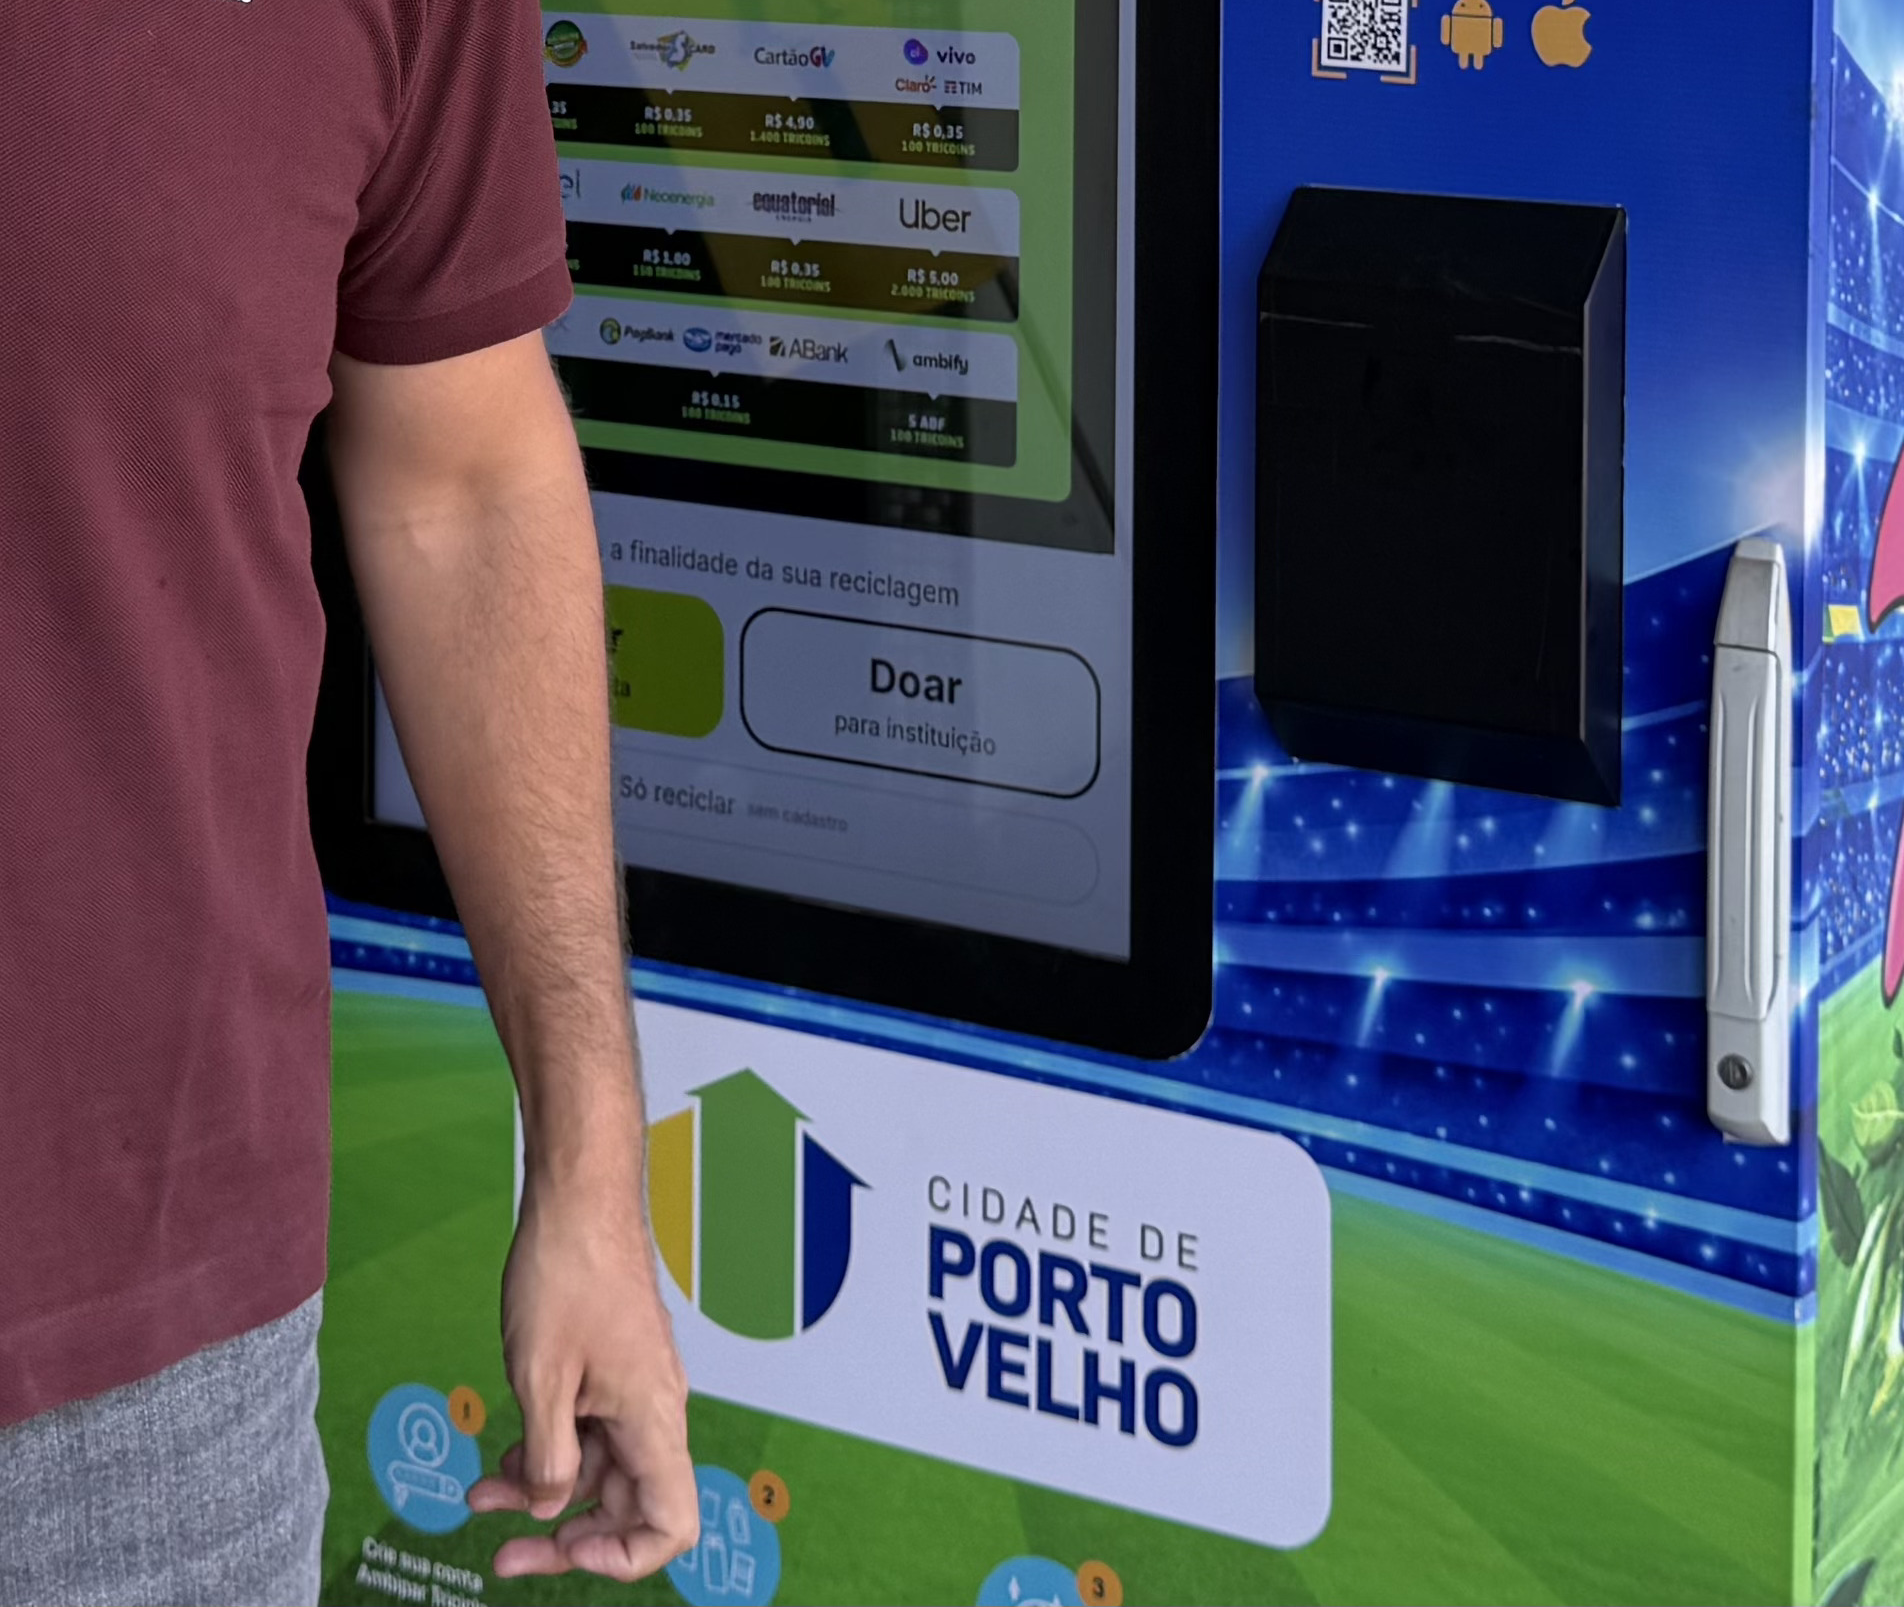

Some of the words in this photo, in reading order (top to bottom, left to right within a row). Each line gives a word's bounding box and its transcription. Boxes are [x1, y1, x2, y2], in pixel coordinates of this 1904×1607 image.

[937, 46, 976, 65] vivo
[896, 76, 934, 93] Claro
[959, 81, 983, 95] TIM
[644, 106, 660, 122] R$
[765, 113, 783, 130] R$
[785, 114, 815, 131] 4,90
[750, 130, 780, 145] 1.400
[782, 131, 831, 147] TRICOINS
[912, 122, 931, 139] R$
[933, 123, 963, 140] 0,35
[901, 139, 923, 153] 100
[925, 140, 976, 157] TRICOINS
[643, 187, 715, 209] Neoenergia
[753, 191, 836, 217] equatorial
[899, 198, 972, 233] Uber
[642, 248, 661, 265] R$
[770, 258, 788, 276] R$
[791, 260, 820, 278] 0,35
[907, 268, 926, 284] R$
[929, 271, 959, 287] 5,00
[760, 274, 781, 289] 100
[783, 276, 831, 293] TRICOINS
[891, 282, 924, 298] 2.000
[926, 286, 975, 303] TRICOINS
[715, 330, 762, 345] mercado
[715, 342, 743, 356] pago
[789, 338, 848, 363] ABank
[912, 352, 969, 375] ambify
[691, 390, 708, 406] R$
[914, 430, 965, 449] TRICOINS
[610, 543, 623, 561] a
[630, 539, 738, 576] finalidade
[745, 556, 774, 581] da
[782, 563, 822, 589] sua
[829, 566, 959, 609] reciclagem
[869, 657, 963, 705] Doar
[834, 711, 882, 737] para
[885, 716, 997, 757] instituição
[619, 773, 648, 801] Só
[653, 777, 736, 817] reciclar
[748, 800, 778, 822] sem
[782, 805, 848, 835] cadastro
[927, 1173, 1110, 1252] CIDADE
[1139, 1221, 1200, 1271] DE
[927, 1224, 1200, 1359] PORTO
[926, 1310, 1200, 1448] VELHO
[462, 1401, 471, 1421] 1
[762, 1485, 775, 1506] 2
[361, 1536, 397, 1568] Crie
[398, 1550, 432, 1578] sua
[432, 1560, 484, 1594] conta
[356, 1562, 427, 1602] Ambipar
[1093, 1576, 1105, 1598] 3
